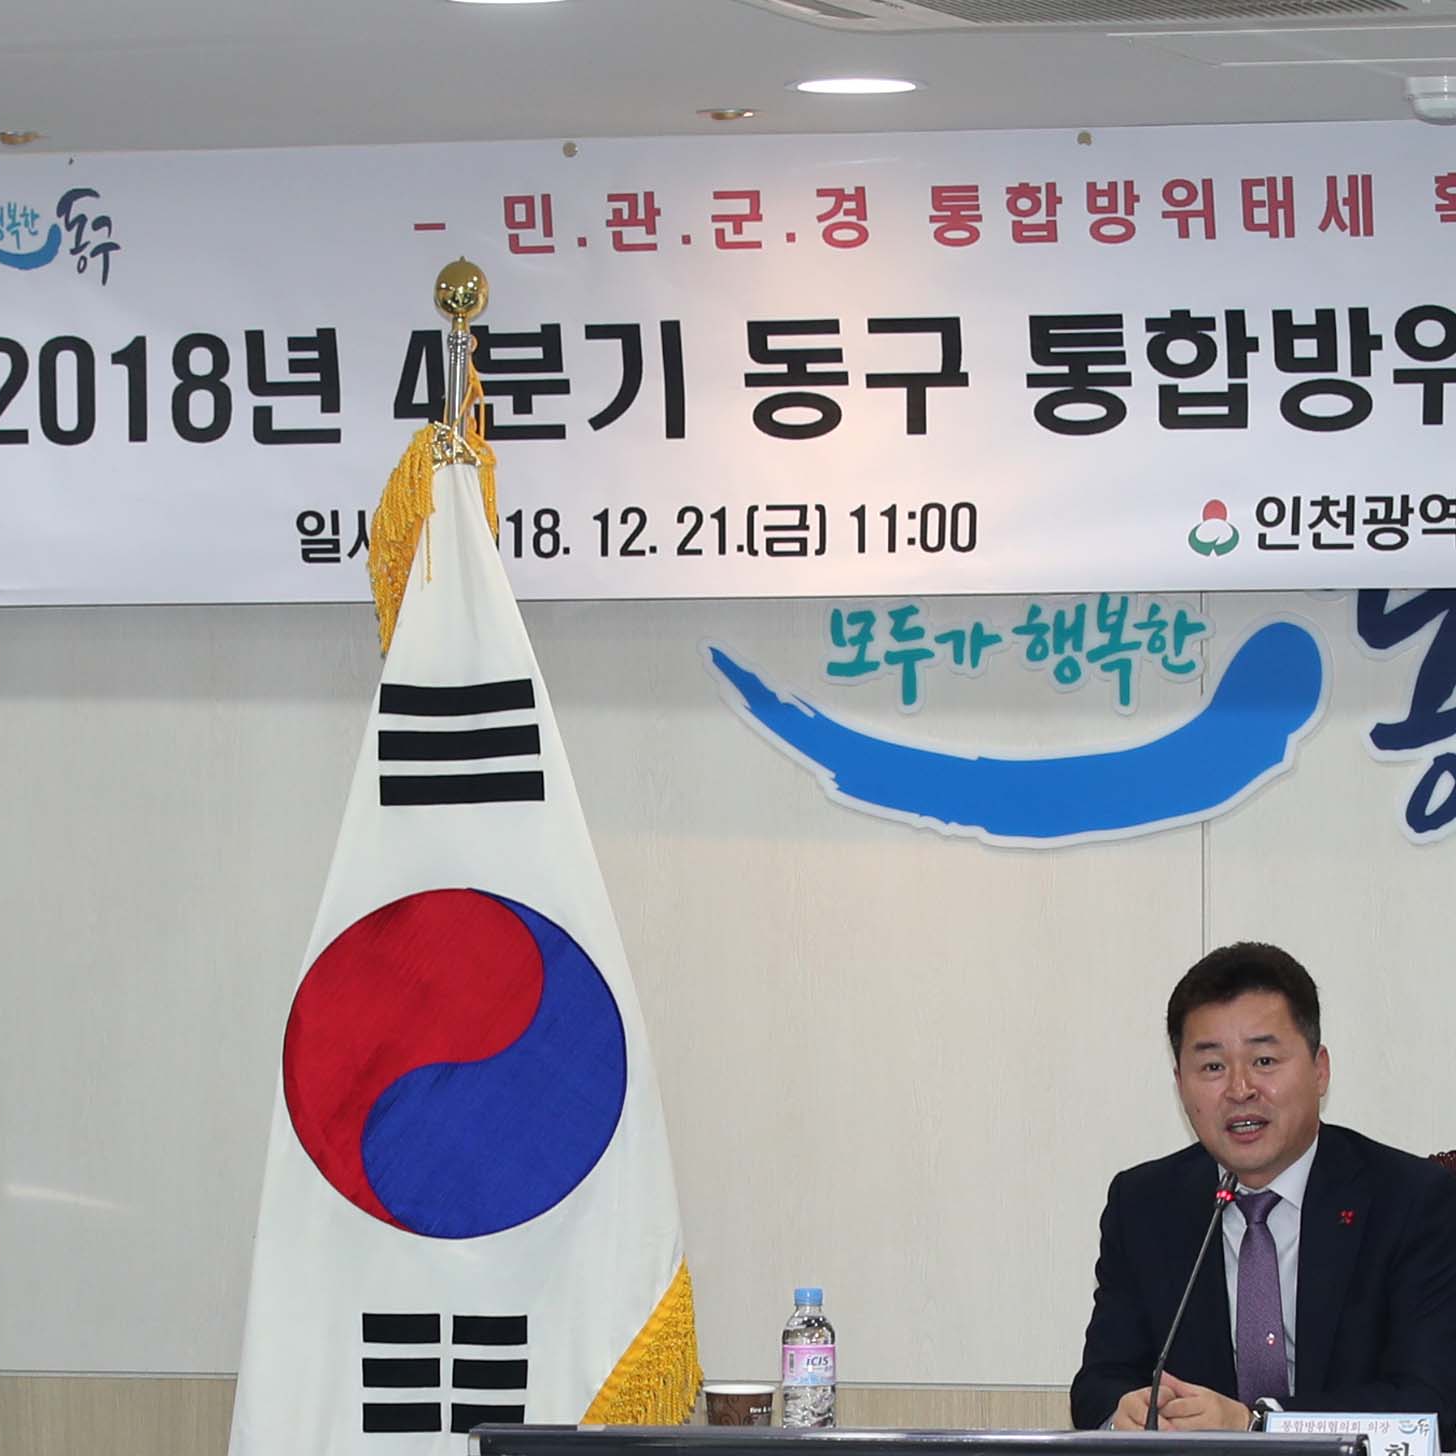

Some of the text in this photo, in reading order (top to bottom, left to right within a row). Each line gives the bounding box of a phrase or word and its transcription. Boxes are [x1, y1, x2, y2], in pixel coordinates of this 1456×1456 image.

[55, 186, 122, 287] 동구
[503, 184, 871, 255] 민.관.군.경
[928, 173, 1375, 248] 통합방위태세
[393, 319, 686, 441] 4분기
[743, 315, 970, 441] 동구
[592, 505, 658, 558] 12.
[848, 500, 978, 554] 11:00
[826, 604, 1003, 706] 모두가
[1011, 592, 1208, 707] 행복한
